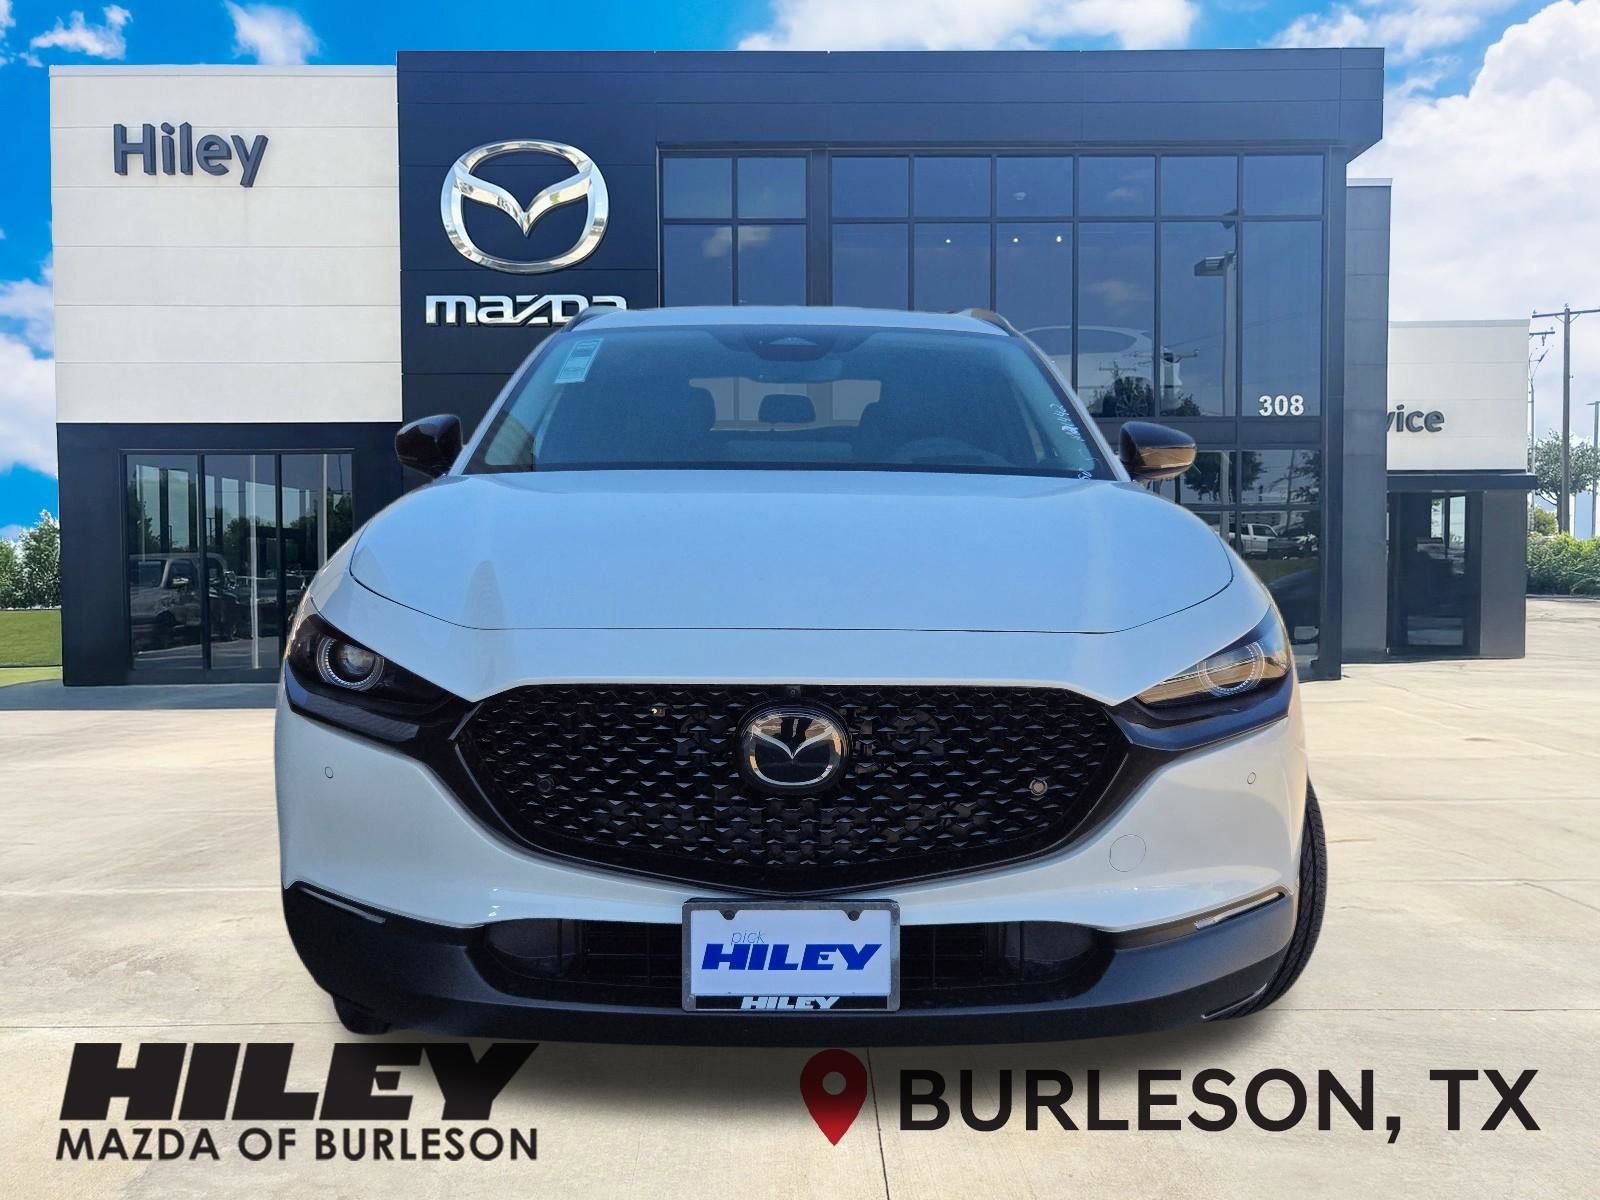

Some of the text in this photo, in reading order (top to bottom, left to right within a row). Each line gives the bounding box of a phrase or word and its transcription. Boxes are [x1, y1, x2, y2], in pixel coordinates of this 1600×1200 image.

[113, 121, 269, 188] Hiley
[1258, 394, 1304, 417] 308
[730, 930, 766, 946] pick
[701, 943, 882, 971] HILEY
[740, 996, 840, 1009] HILEY
